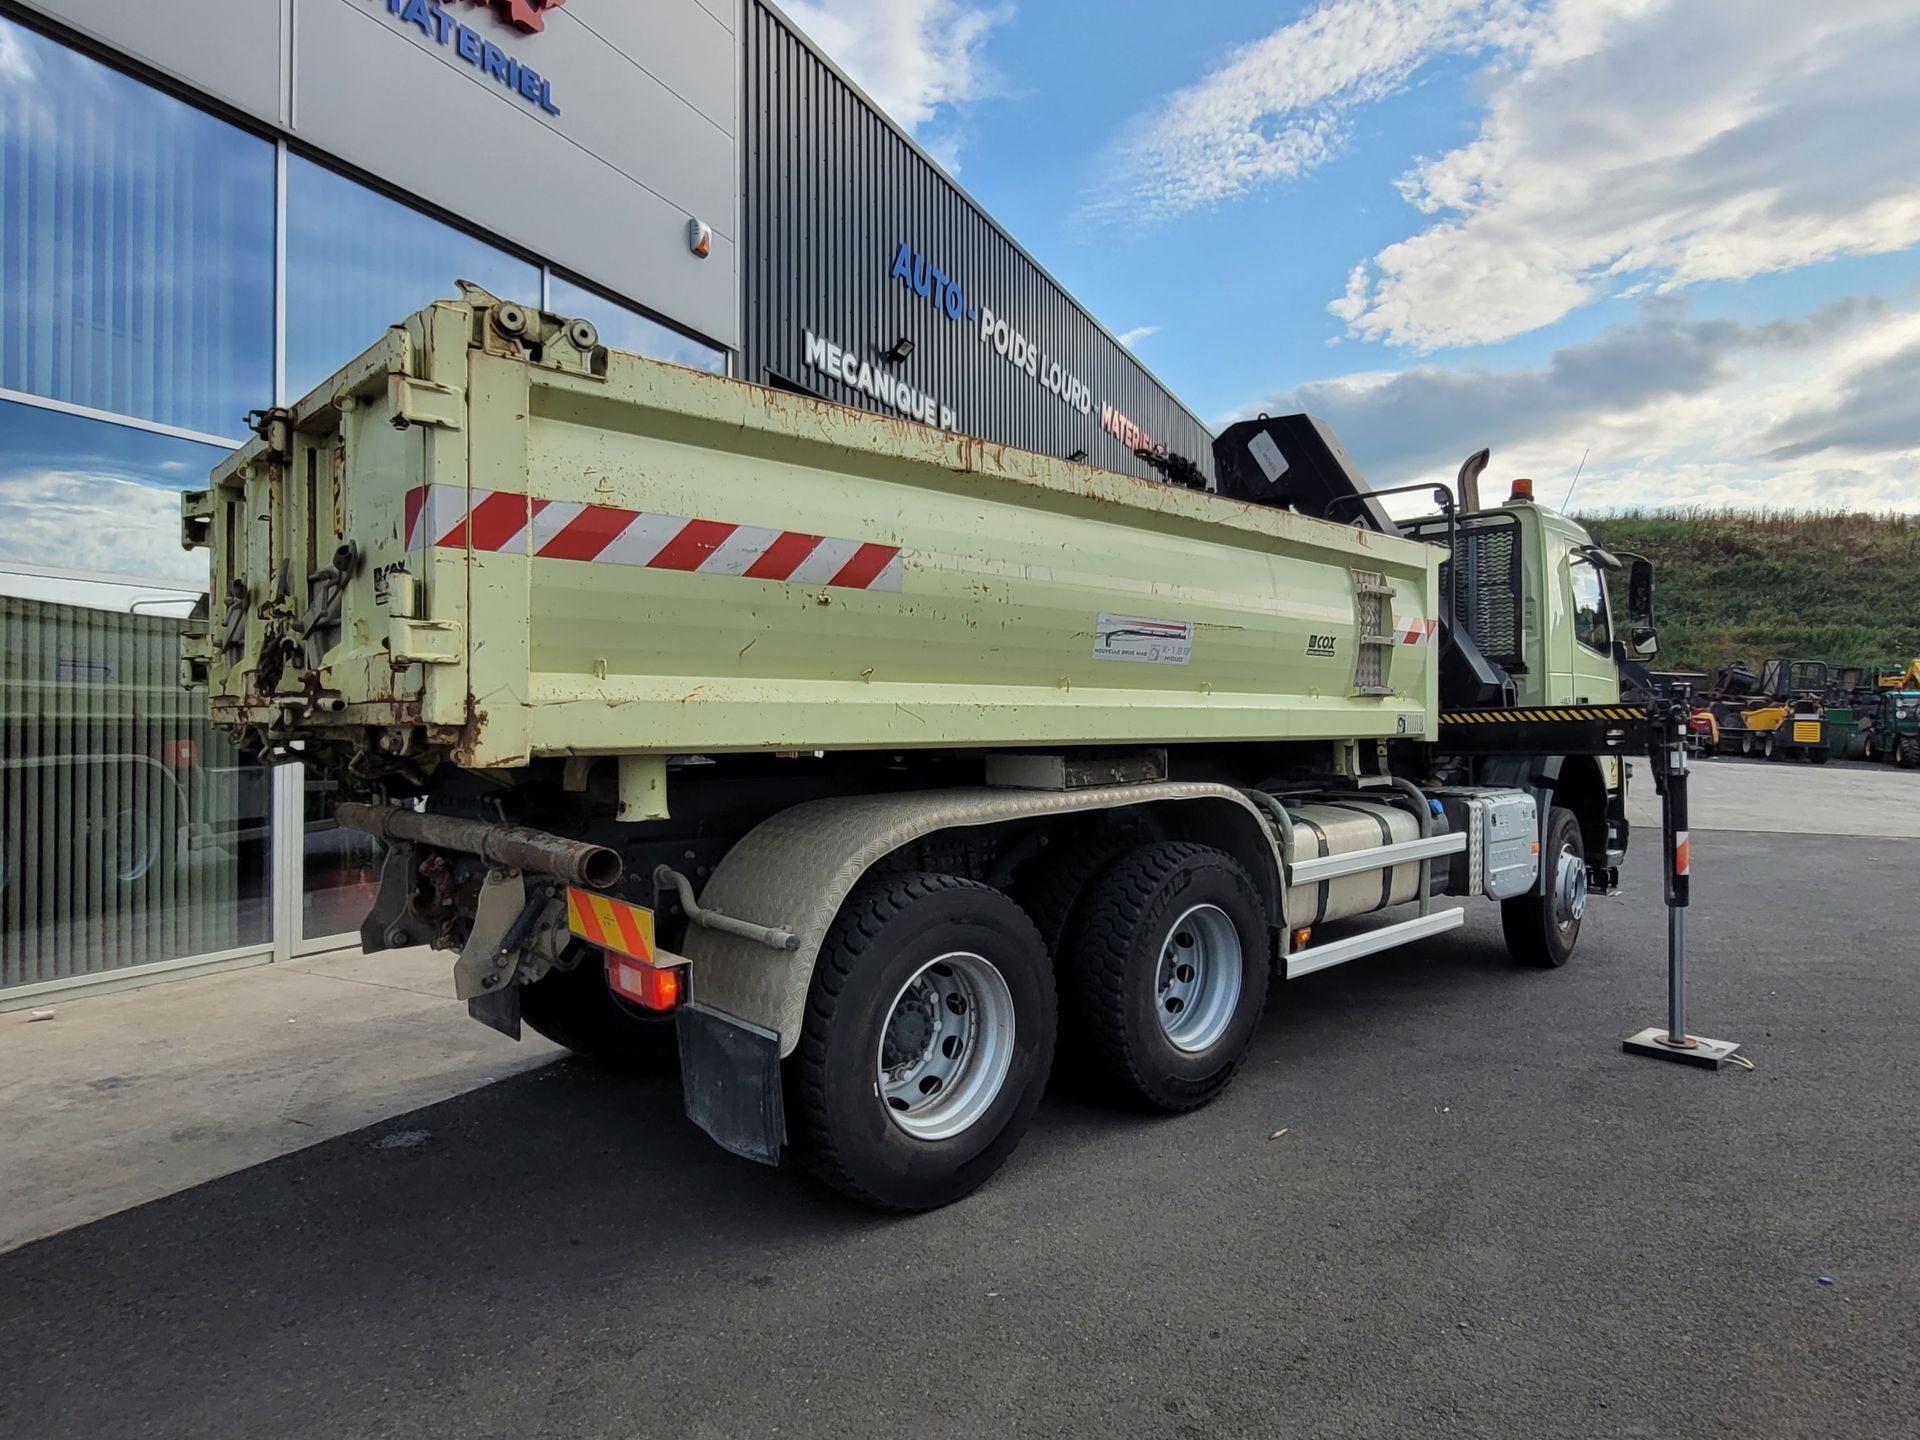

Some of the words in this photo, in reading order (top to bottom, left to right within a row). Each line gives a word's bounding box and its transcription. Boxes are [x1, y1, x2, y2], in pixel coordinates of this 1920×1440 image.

[386, 0, 561, 116] ATERIEL
[805, 330, 937, 427] MECANIQUE
[891, 241, 964, 321] AUTO
[980, 305, 1038, 378] POIDS
[1040, 353, 1091, 416] LOURD
[1317, 635, 1337, 650] COX
